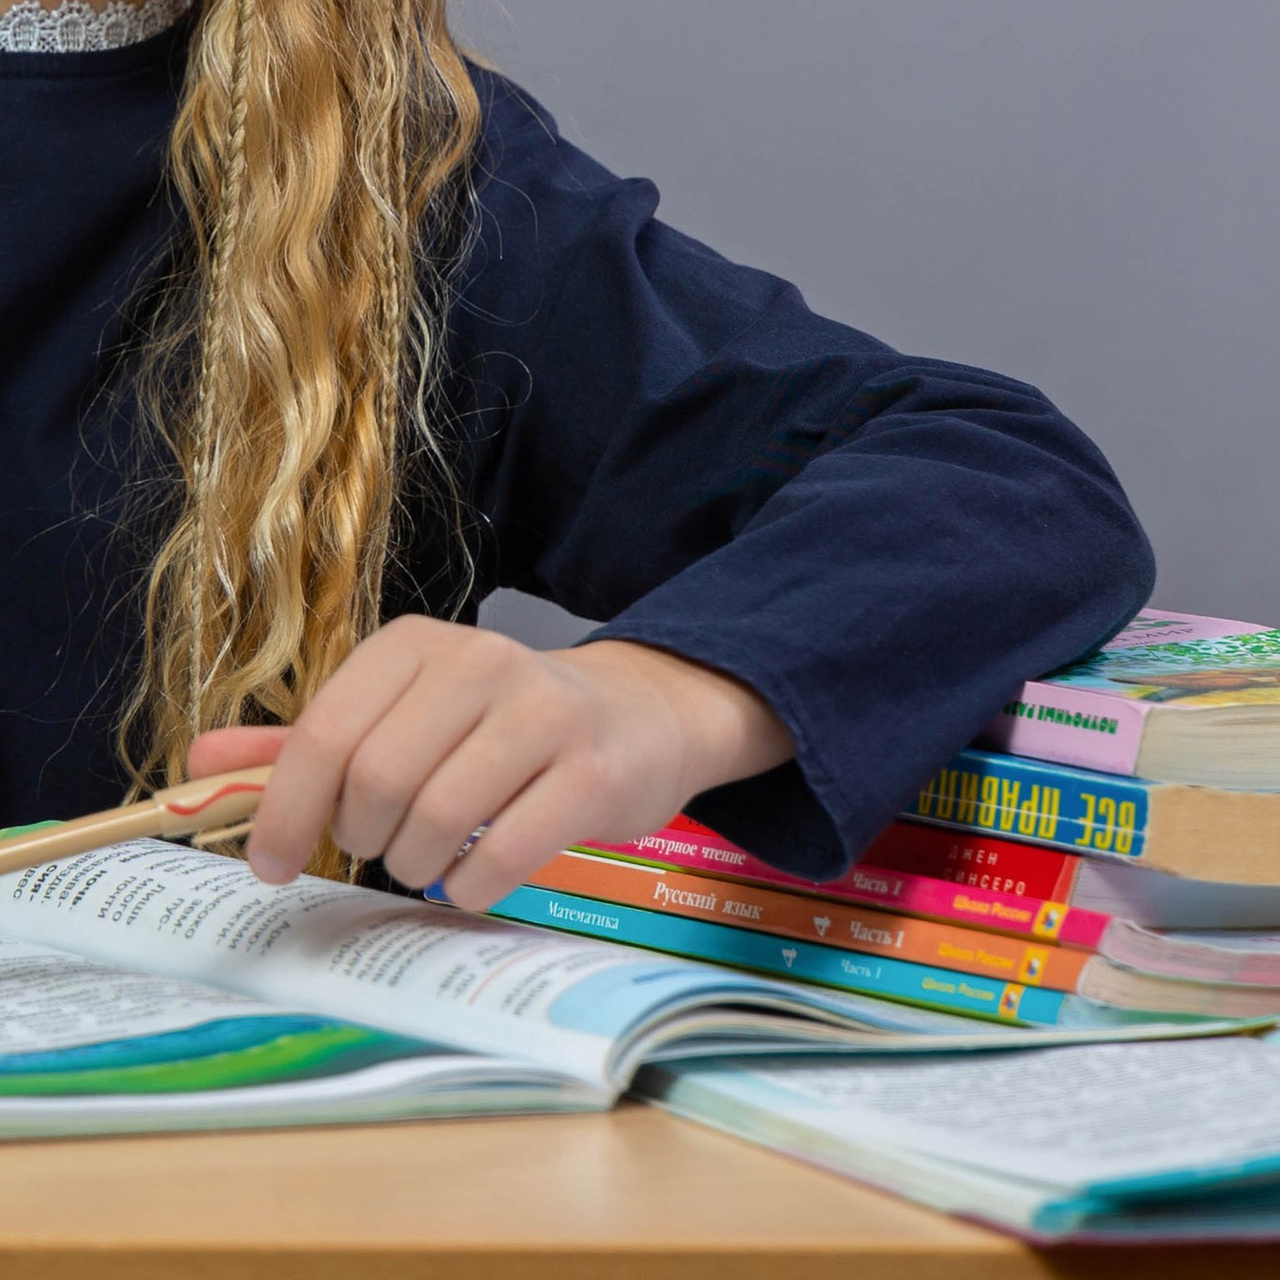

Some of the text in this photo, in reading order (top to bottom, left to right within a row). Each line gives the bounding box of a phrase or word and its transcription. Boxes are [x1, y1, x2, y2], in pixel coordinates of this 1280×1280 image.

[1037, 705, 1118, 734] ПОУРОЧНЫЕ
[1075, 792, 1136, 854] ВСЕ
[628, 835, 698, 856] ературное
[701, 846, 747, 866] чтение
[853, 872, 890, 895] Часть
[949, 845, 999, 866] ДЖЕН
[29, 864, 58, 902] сия-
[69, 869, 108, 910] ночь.
[97, 875, 138, 919] почти
[111, 877, 155, 922] много
[126, 882, 166, 926] Лишь
[944, 869, 1027, 895] СИНСЕРО
[156, 897, 185, 932] пус-
[171, 898, 203, 935] зем-
[184, 888, 238, 940] высоко
[216, 898, 262, 945] Аркти-
[245, 907, 289, 952] полю-
[652, 880, 718, 912] Русский
[721, 897, 764, 920] язык
[850, 920, 892, 946] Часть
[894, 930, 906, 949] 1
[258, 920, 292, 956] Арк-
[547, 900, 620, 931] Математика
[840, 957, 871, 979] Часть
